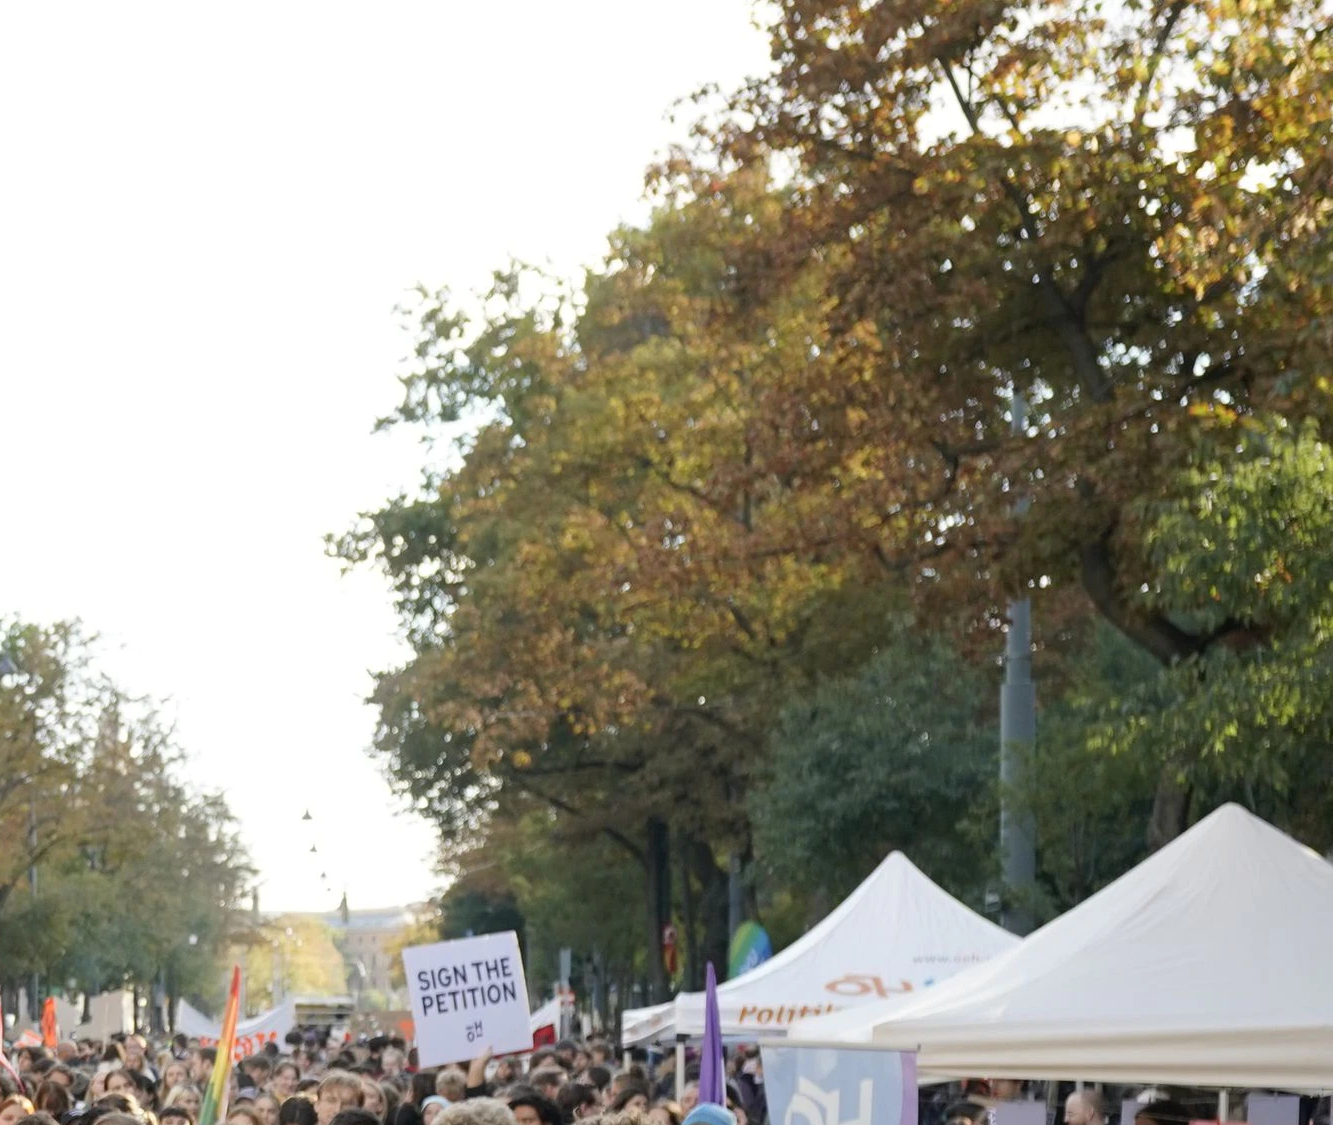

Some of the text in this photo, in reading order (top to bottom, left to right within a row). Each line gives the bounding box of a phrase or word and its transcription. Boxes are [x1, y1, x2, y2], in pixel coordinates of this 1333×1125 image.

[417, 957, 512, 991] SIGN THE
[421, 981, 517, 1017] PETITION
